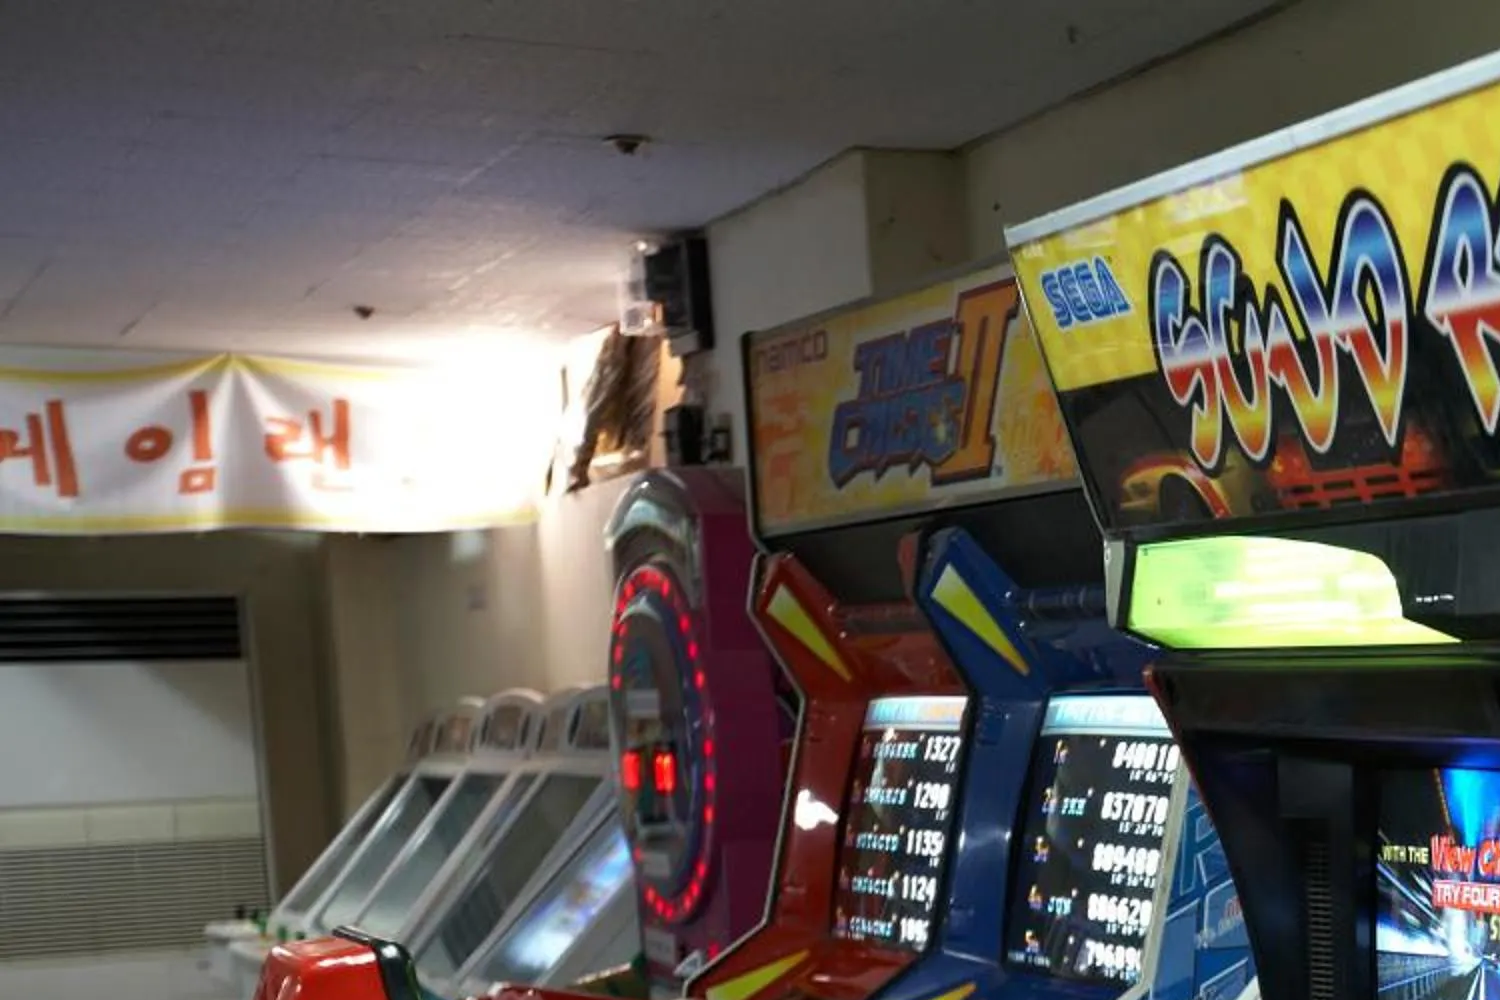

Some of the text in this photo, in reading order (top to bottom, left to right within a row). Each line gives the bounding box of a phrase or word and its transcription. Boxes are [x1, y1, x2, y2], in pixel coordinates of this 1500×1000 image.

[1041, 256, 1131, 329] SEGA
[853, 318, 960, 399] TIME
[1408, 846, 1429, 864] THE
[1430, 833, 1476, 874] View
[1434, 883, 1460, 904] TRY
[1463, 886, 1500, 908] FOUR
